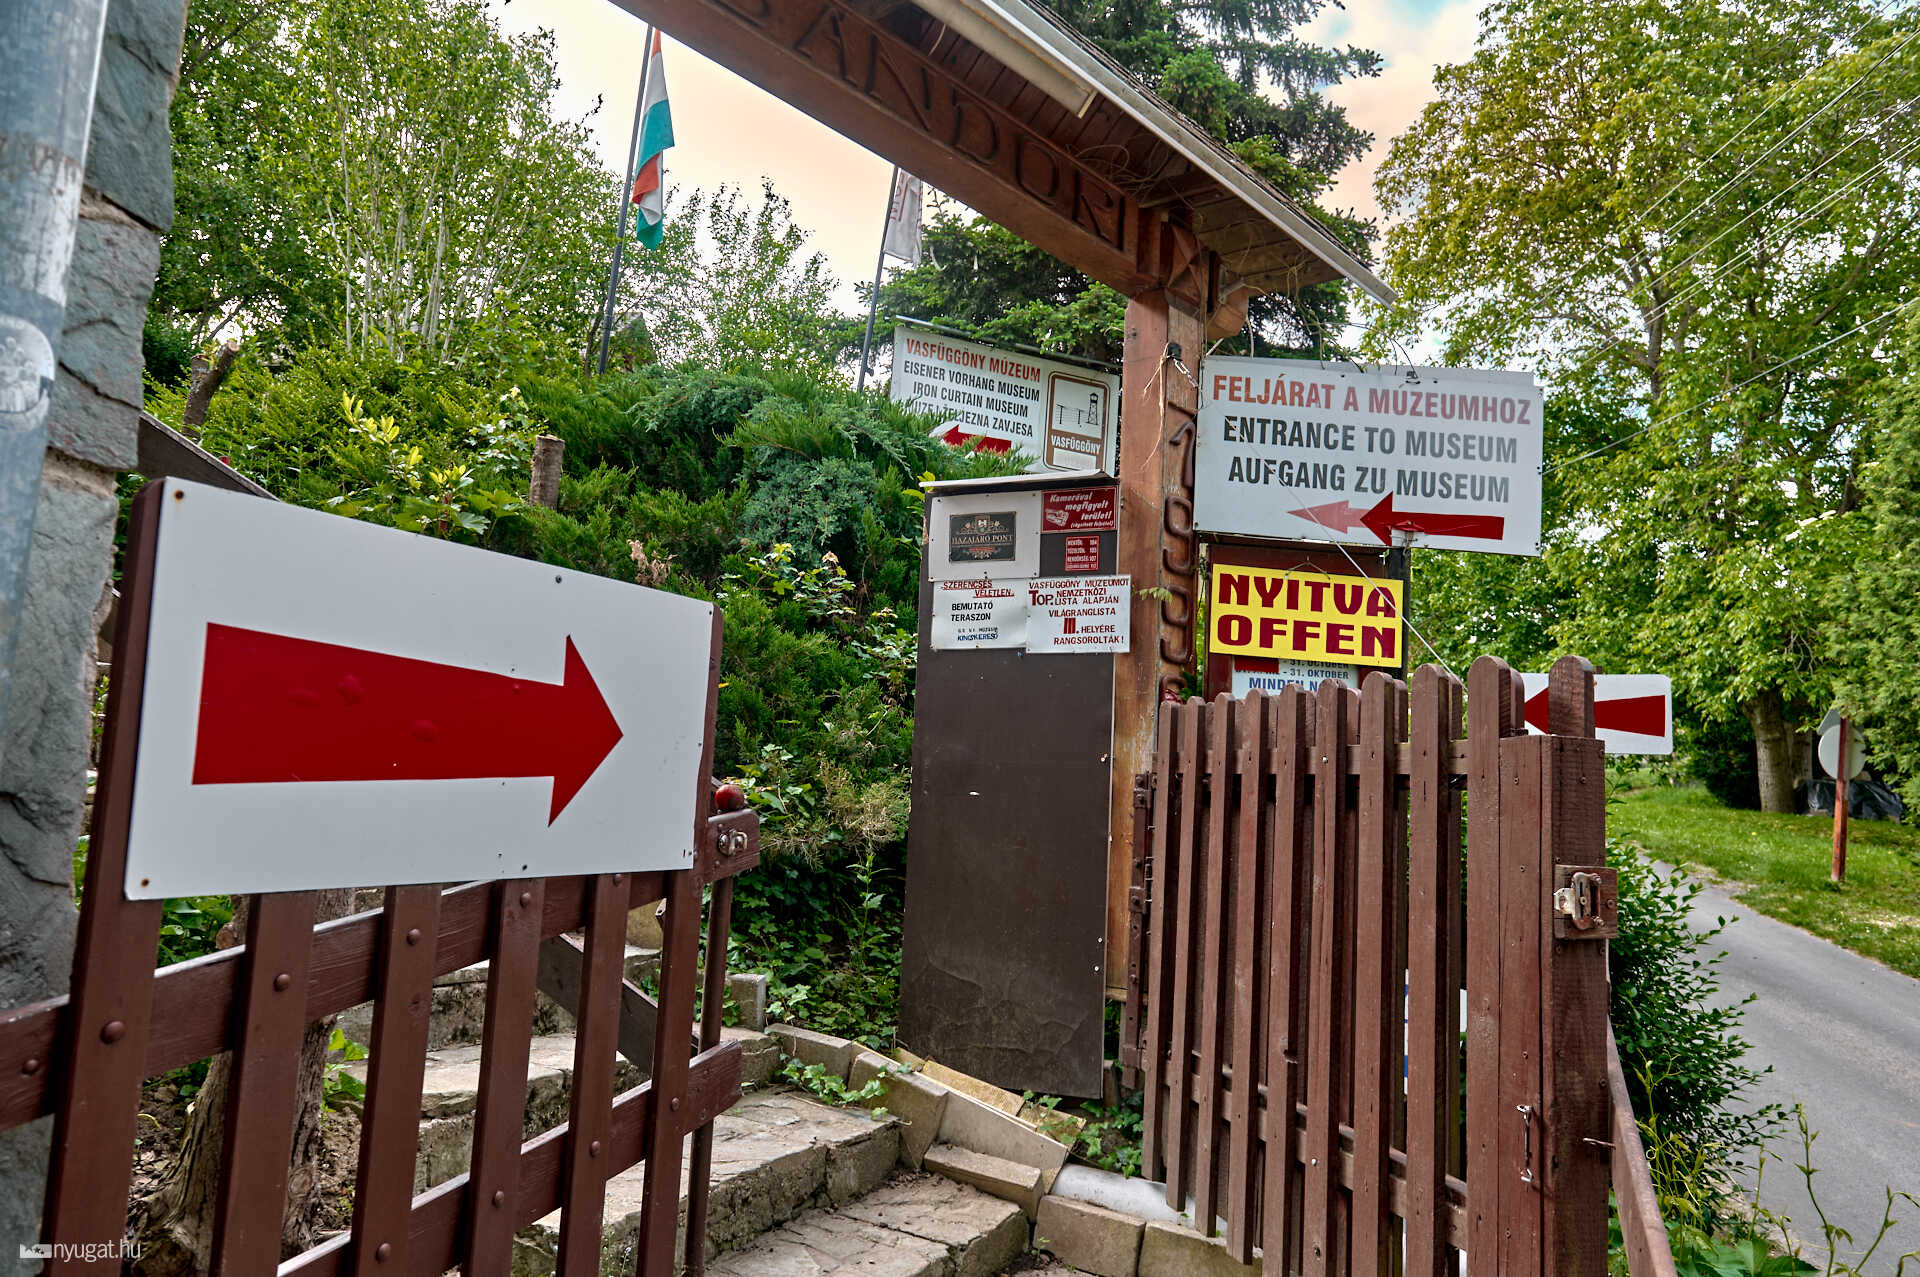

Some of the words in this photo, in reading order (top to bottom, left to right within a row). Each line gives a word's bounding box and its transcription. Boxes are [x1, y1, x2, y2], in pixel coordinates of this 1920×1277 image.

[906, 338, 986, 369] VASFÜGGÖNY
[989, 357, 1041, 382] MÚZEUM
[904, 360, 945, 381] EISENER
[949, 370, 994, 391] VORHANG
[998, 381, 1040, 402] MUSEUM
[913, 381, 937, 398] IRON
[941, 387, 982, 408] CURTAIN
[986, 397, 1028, 418] MUSEUM
[1213, 373, 1336, 410] FELJÁRAT
[1344, 386, 1359, 412] A
[1369, 384, 1531, 425] MÚZEUMHOZ
[993, 417, 1033, 437] ZAVJESA
[1224, 415, 1355, 450] ENTRANCE
[1365, 426, 1395, 455] TO
[1405, 430, 1517, 464] MUSEUM
[1051, 434, 1101, 455] VASFÜGGÖNY
[1228, 456, 1345, 491] AUFGANG
[1354, 466, 1386, 494] ZU
[1396, 469, 1510, 503] MUSEUM
[952, 600, 993, 611] BEMUTATÓ
[1055, 597, 1077, 605] LISTA
[1082, 595, 1119, 604] ALAPJÁN
[1218, 573, 1396, 618] NYITVA
[951, 613, 991, 621] TERASZON
[1049, 607, 1116, 617] VILÁGRANGLISTA
[1063, 617, 1079, 634] III.
[1081, 624, 1115, 633] HELYÉRE
[1217, 614, 1395, 659] OFFEN
[1307, 669, 1349, 679] OKTOBER
